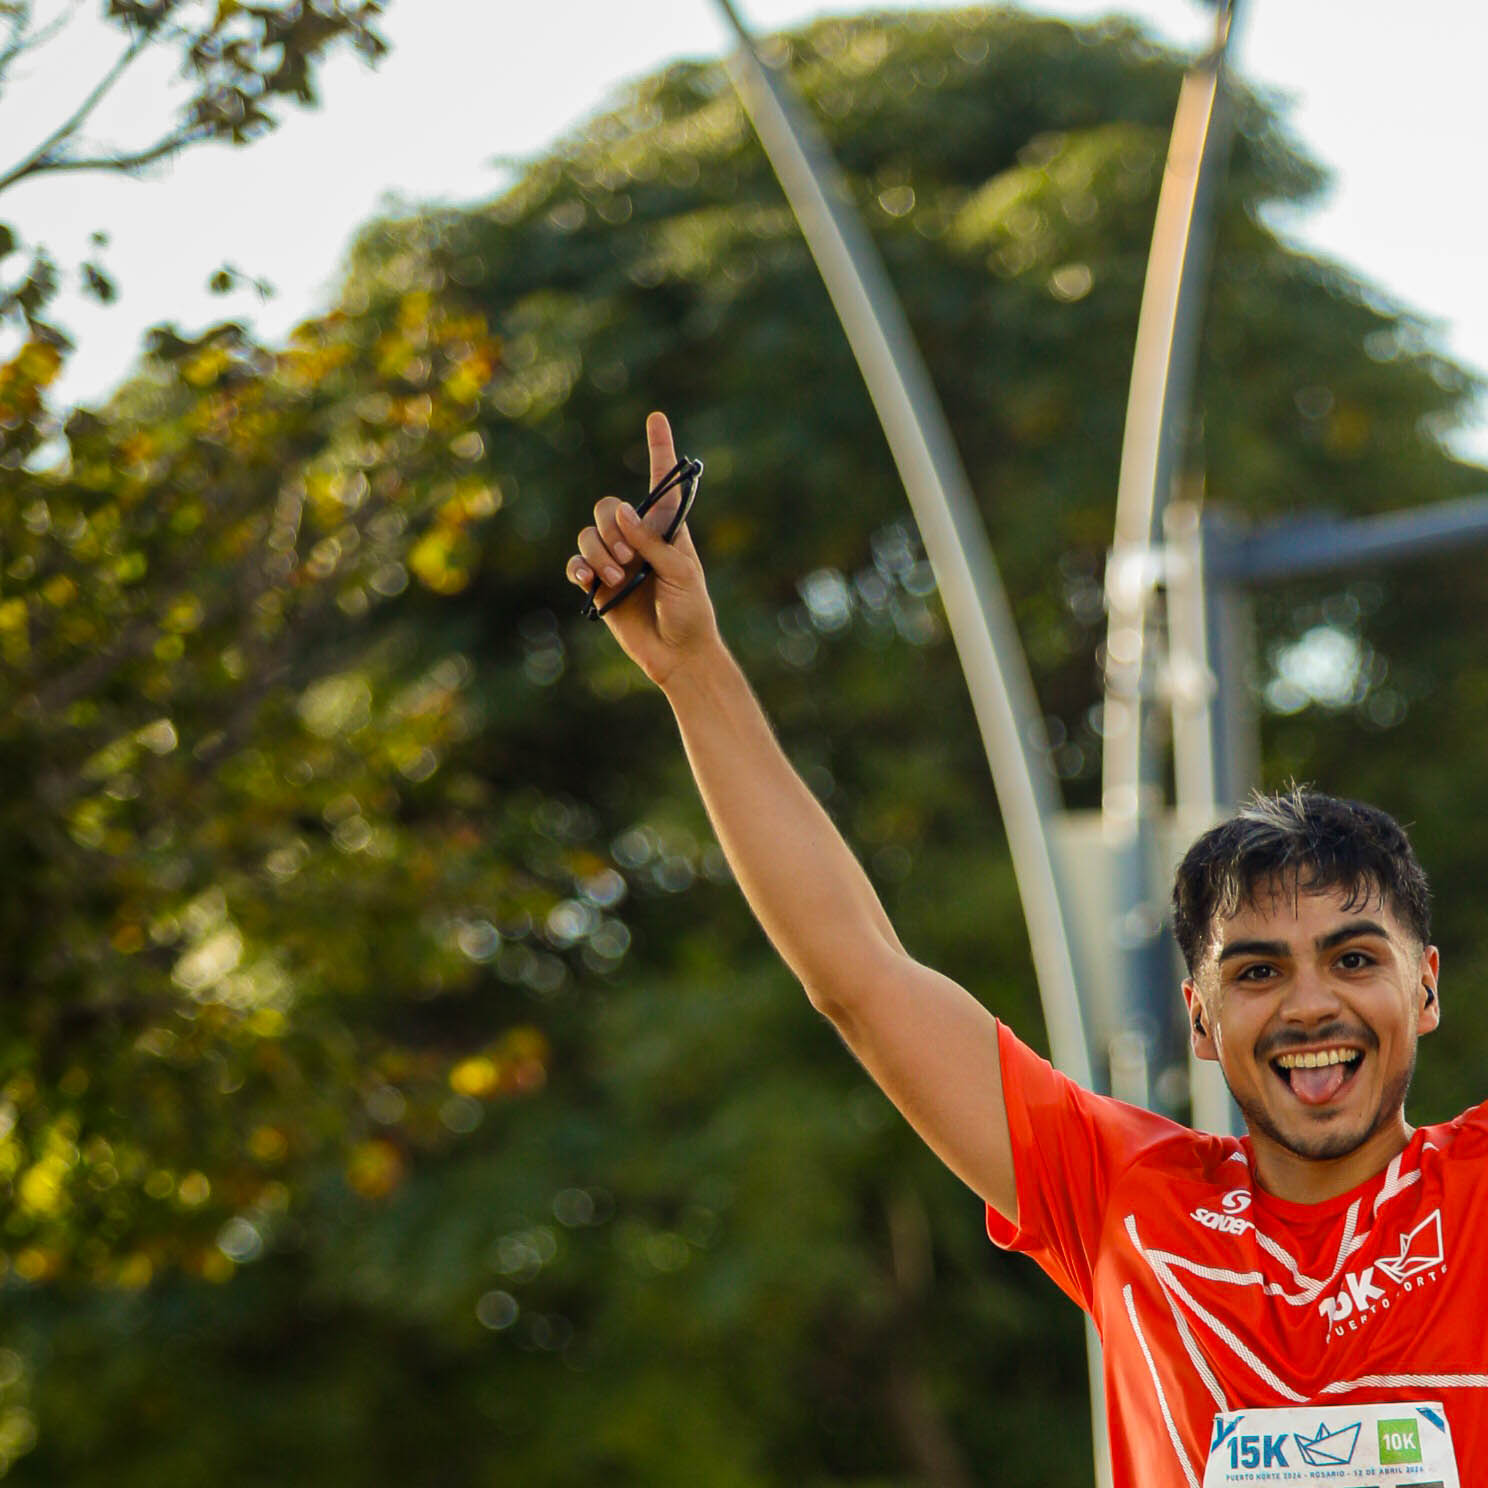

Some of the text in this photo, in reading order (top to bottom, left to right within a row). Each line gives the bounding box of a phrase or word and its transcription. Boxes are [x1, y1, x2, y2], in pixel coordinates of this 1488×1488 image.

[1227, 1433, 1290, 1469] 15K
[1383, 1431, 1417, 1451] 10K
[1309, 1470, 1345, 1479] ROSARIO
